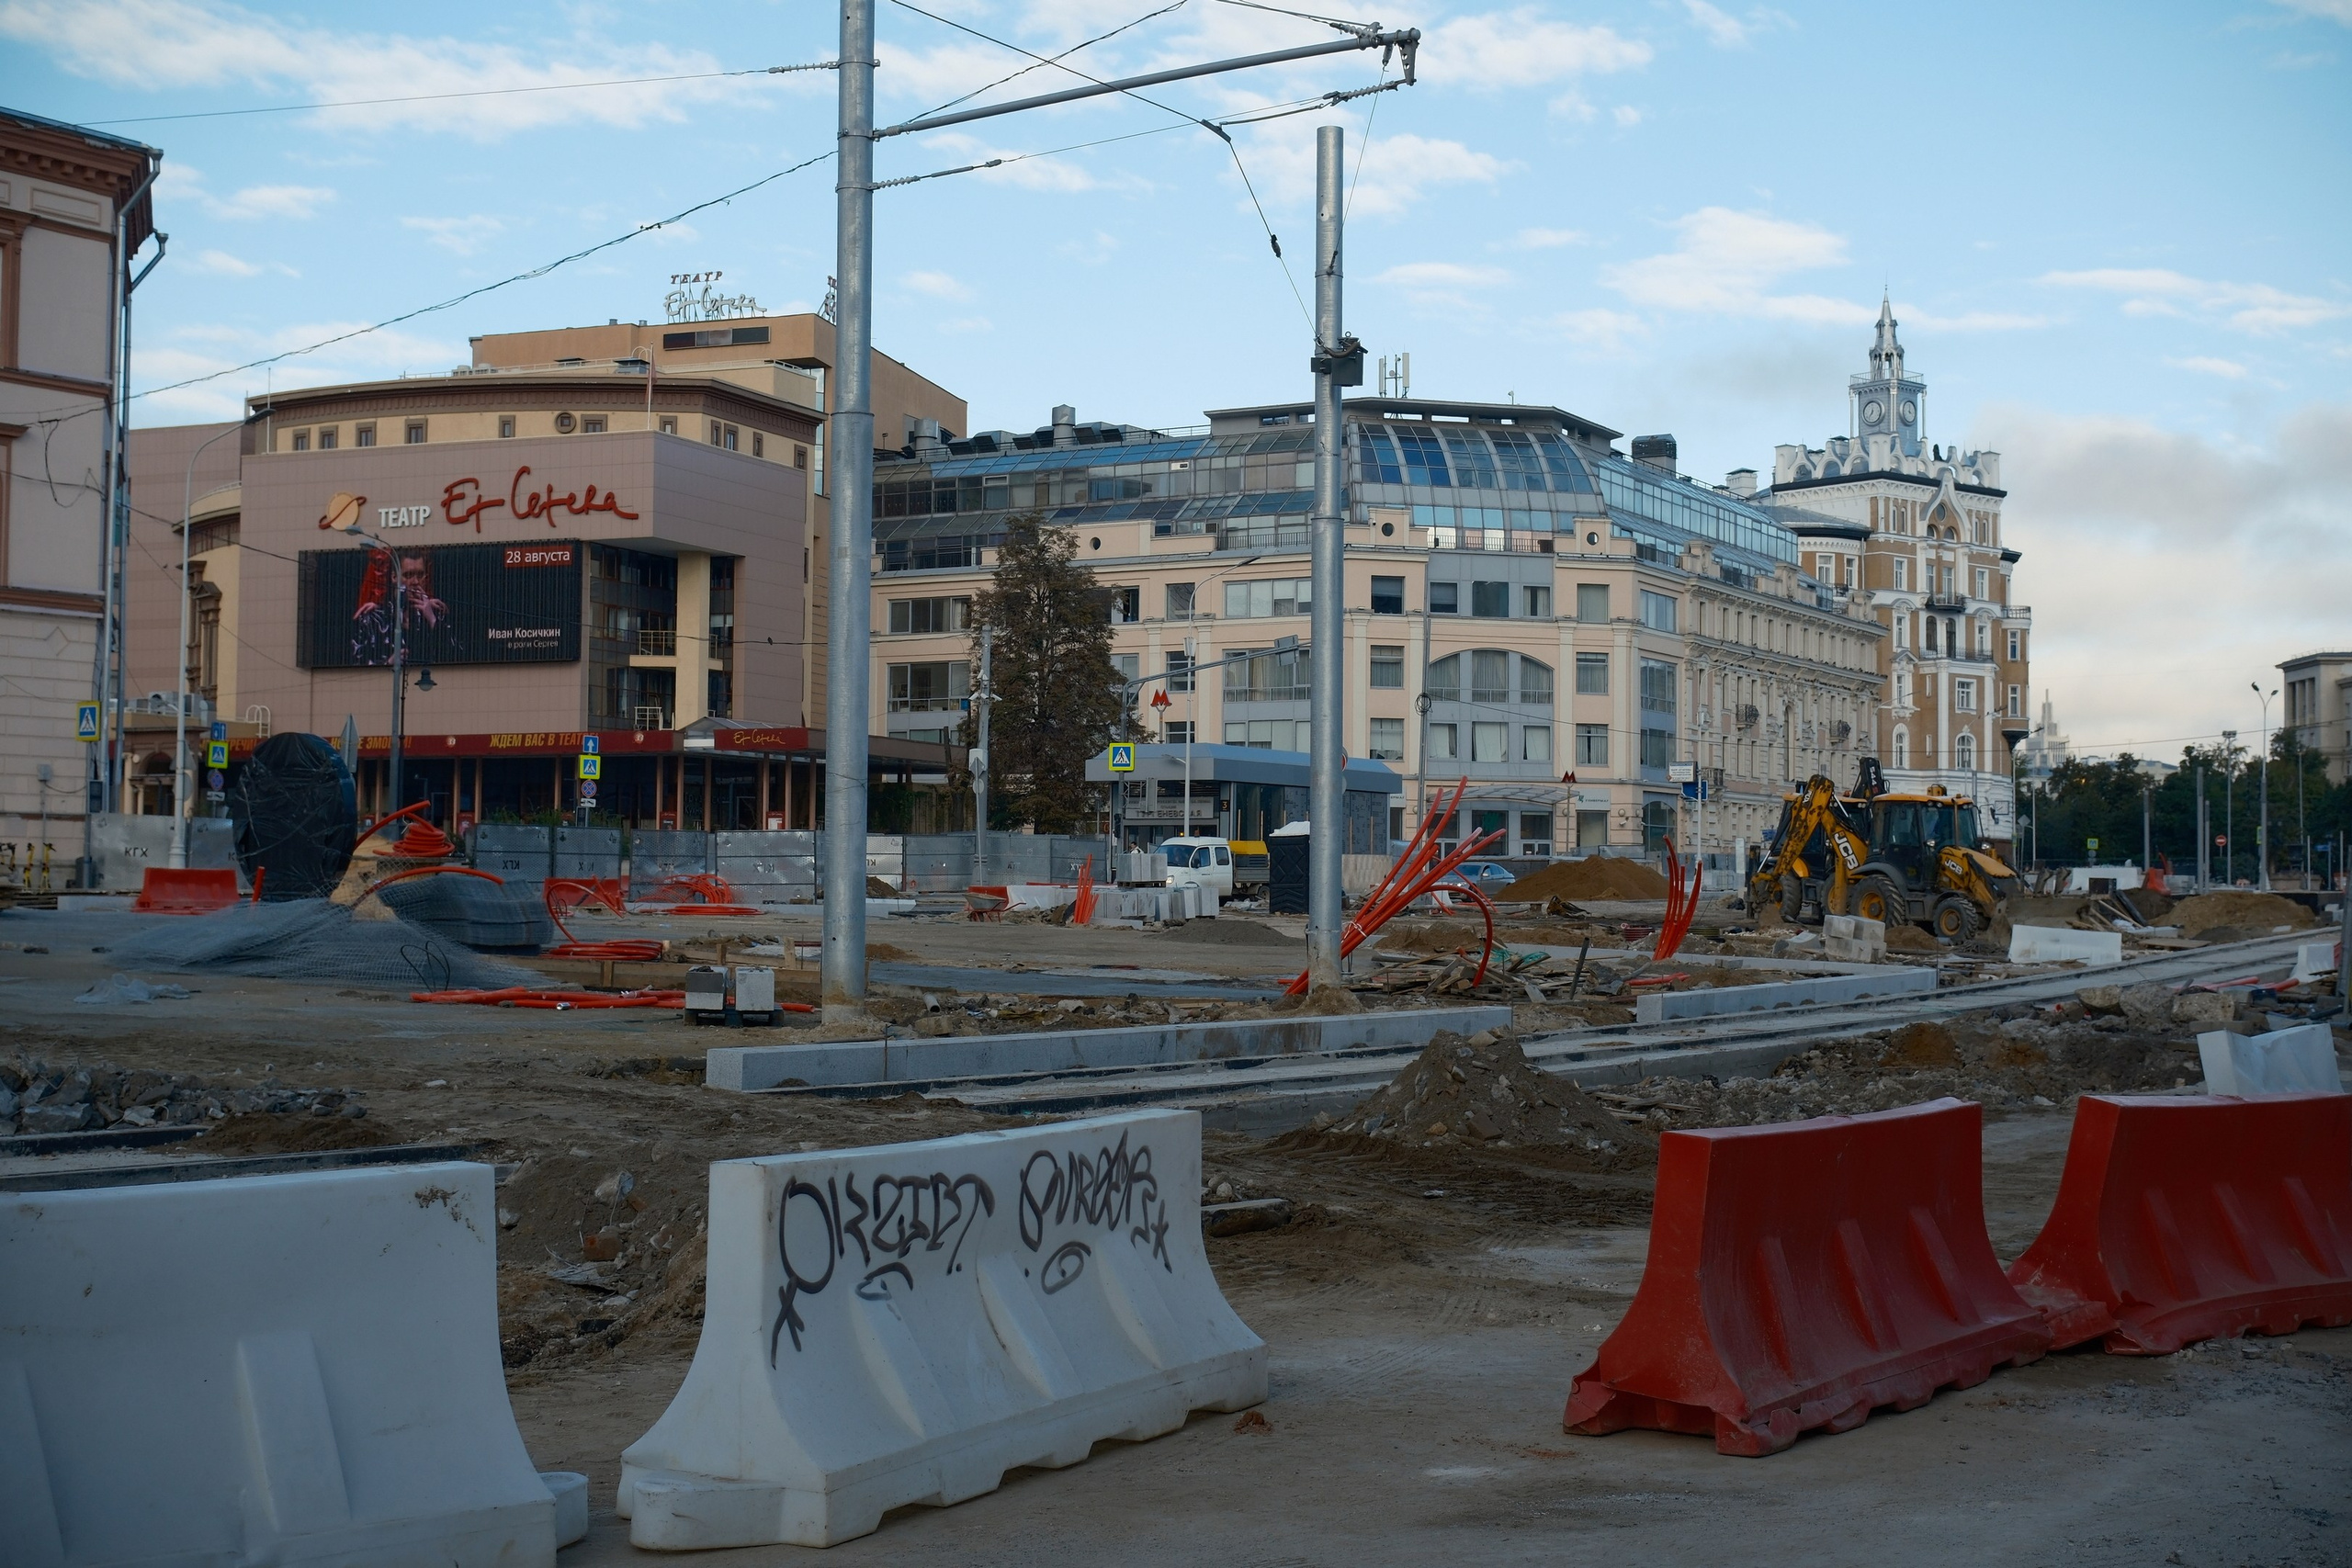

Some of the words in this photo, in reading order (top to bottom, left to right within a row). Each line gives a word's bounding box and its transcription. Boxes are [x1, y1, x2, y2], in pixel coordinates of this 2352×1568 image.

[671, 271, 722, 284] ТЕАТР
[441, 477, 505, 534] Et
[378, 504, 432, 528] ТЕАТР
[505, 550, 521, 564] 28
[525, 550, 571, 566] августа
[488, 628, 513, 640] Иван
[514, 627, 561, 639] Косичкин
[490, 734, 523, 749] ЖДЕМ
[525, 734, 545, 747] ВАС
[548, 733, 556, 746] В
[1136, 809, 1203, 818] ТУРГЕНЕВСАЯ
[124, 847, 149, 858] КГХ
[1834, 831, 1860, 870] JCB
[1944, 858, 1963, 875] JCB
